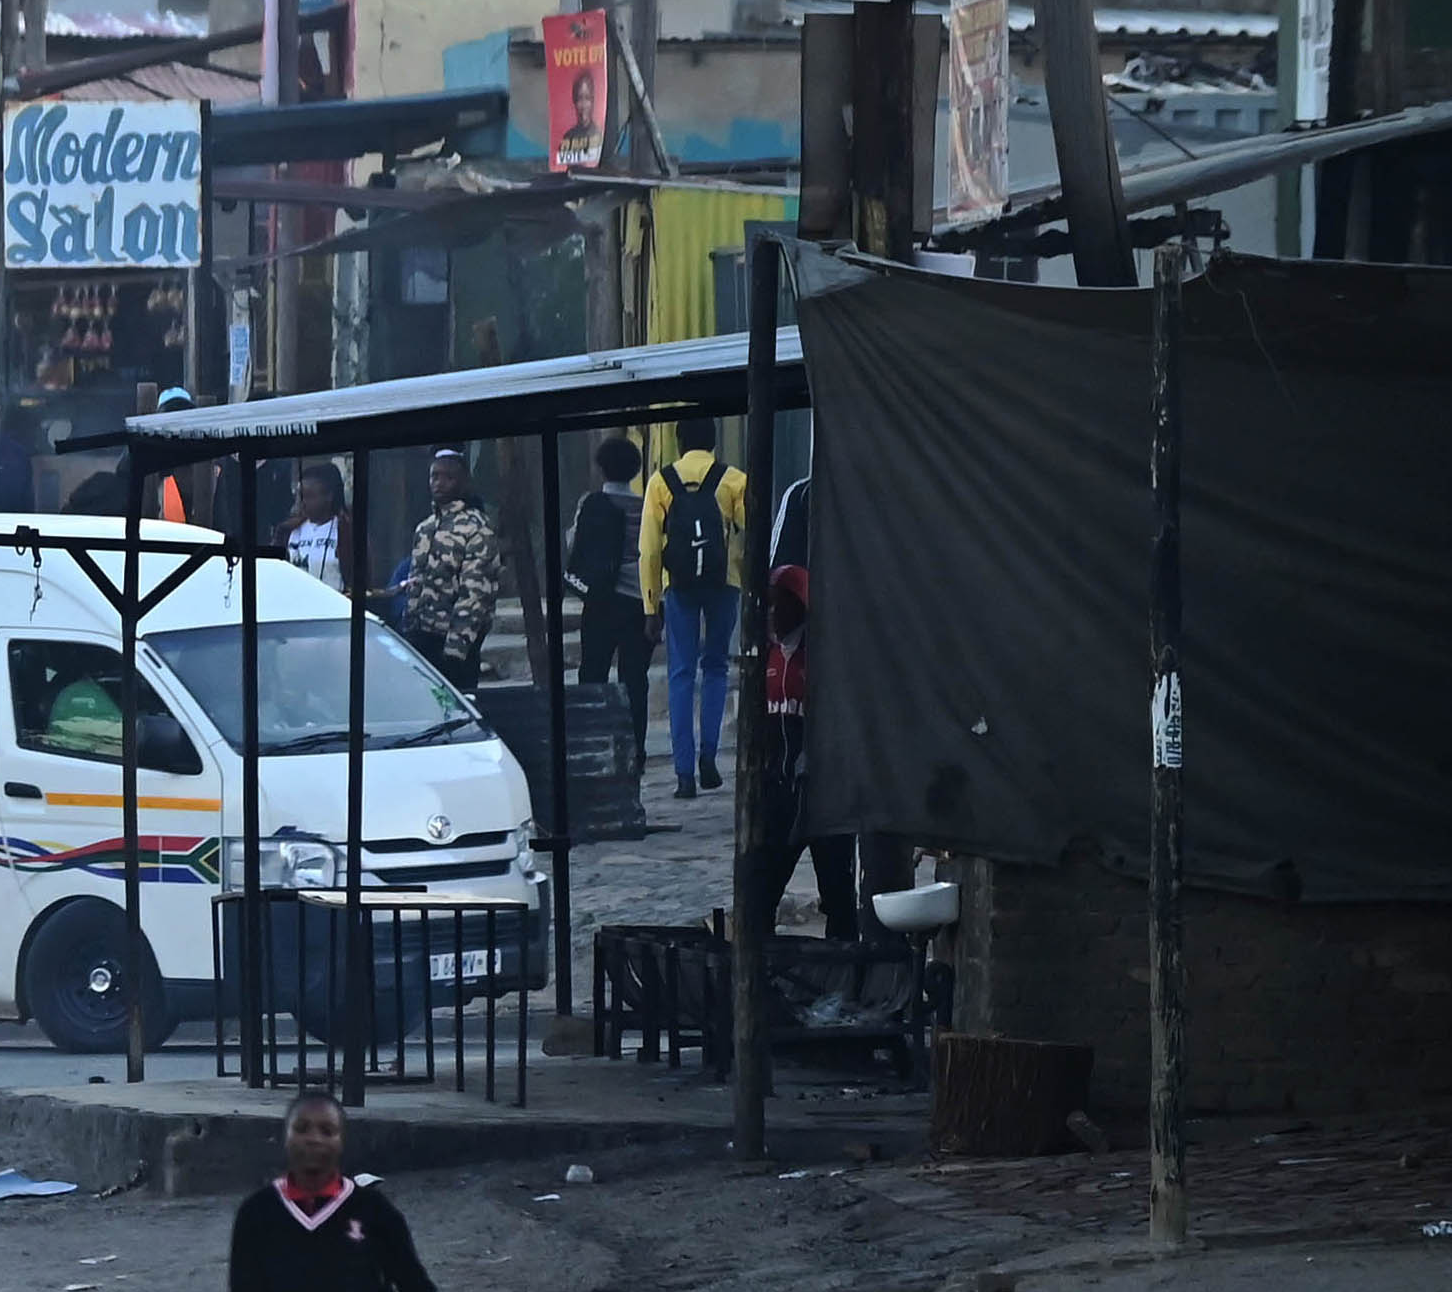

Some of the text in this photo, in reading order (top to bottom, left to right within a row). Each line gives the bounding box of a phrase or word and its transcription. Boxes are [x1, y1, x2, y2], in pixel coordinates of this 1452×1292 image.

[554, 47, 587, 67] VOTE
[5, 104, 200, 186] Modern
[6, 186, 200, 263] Salon
